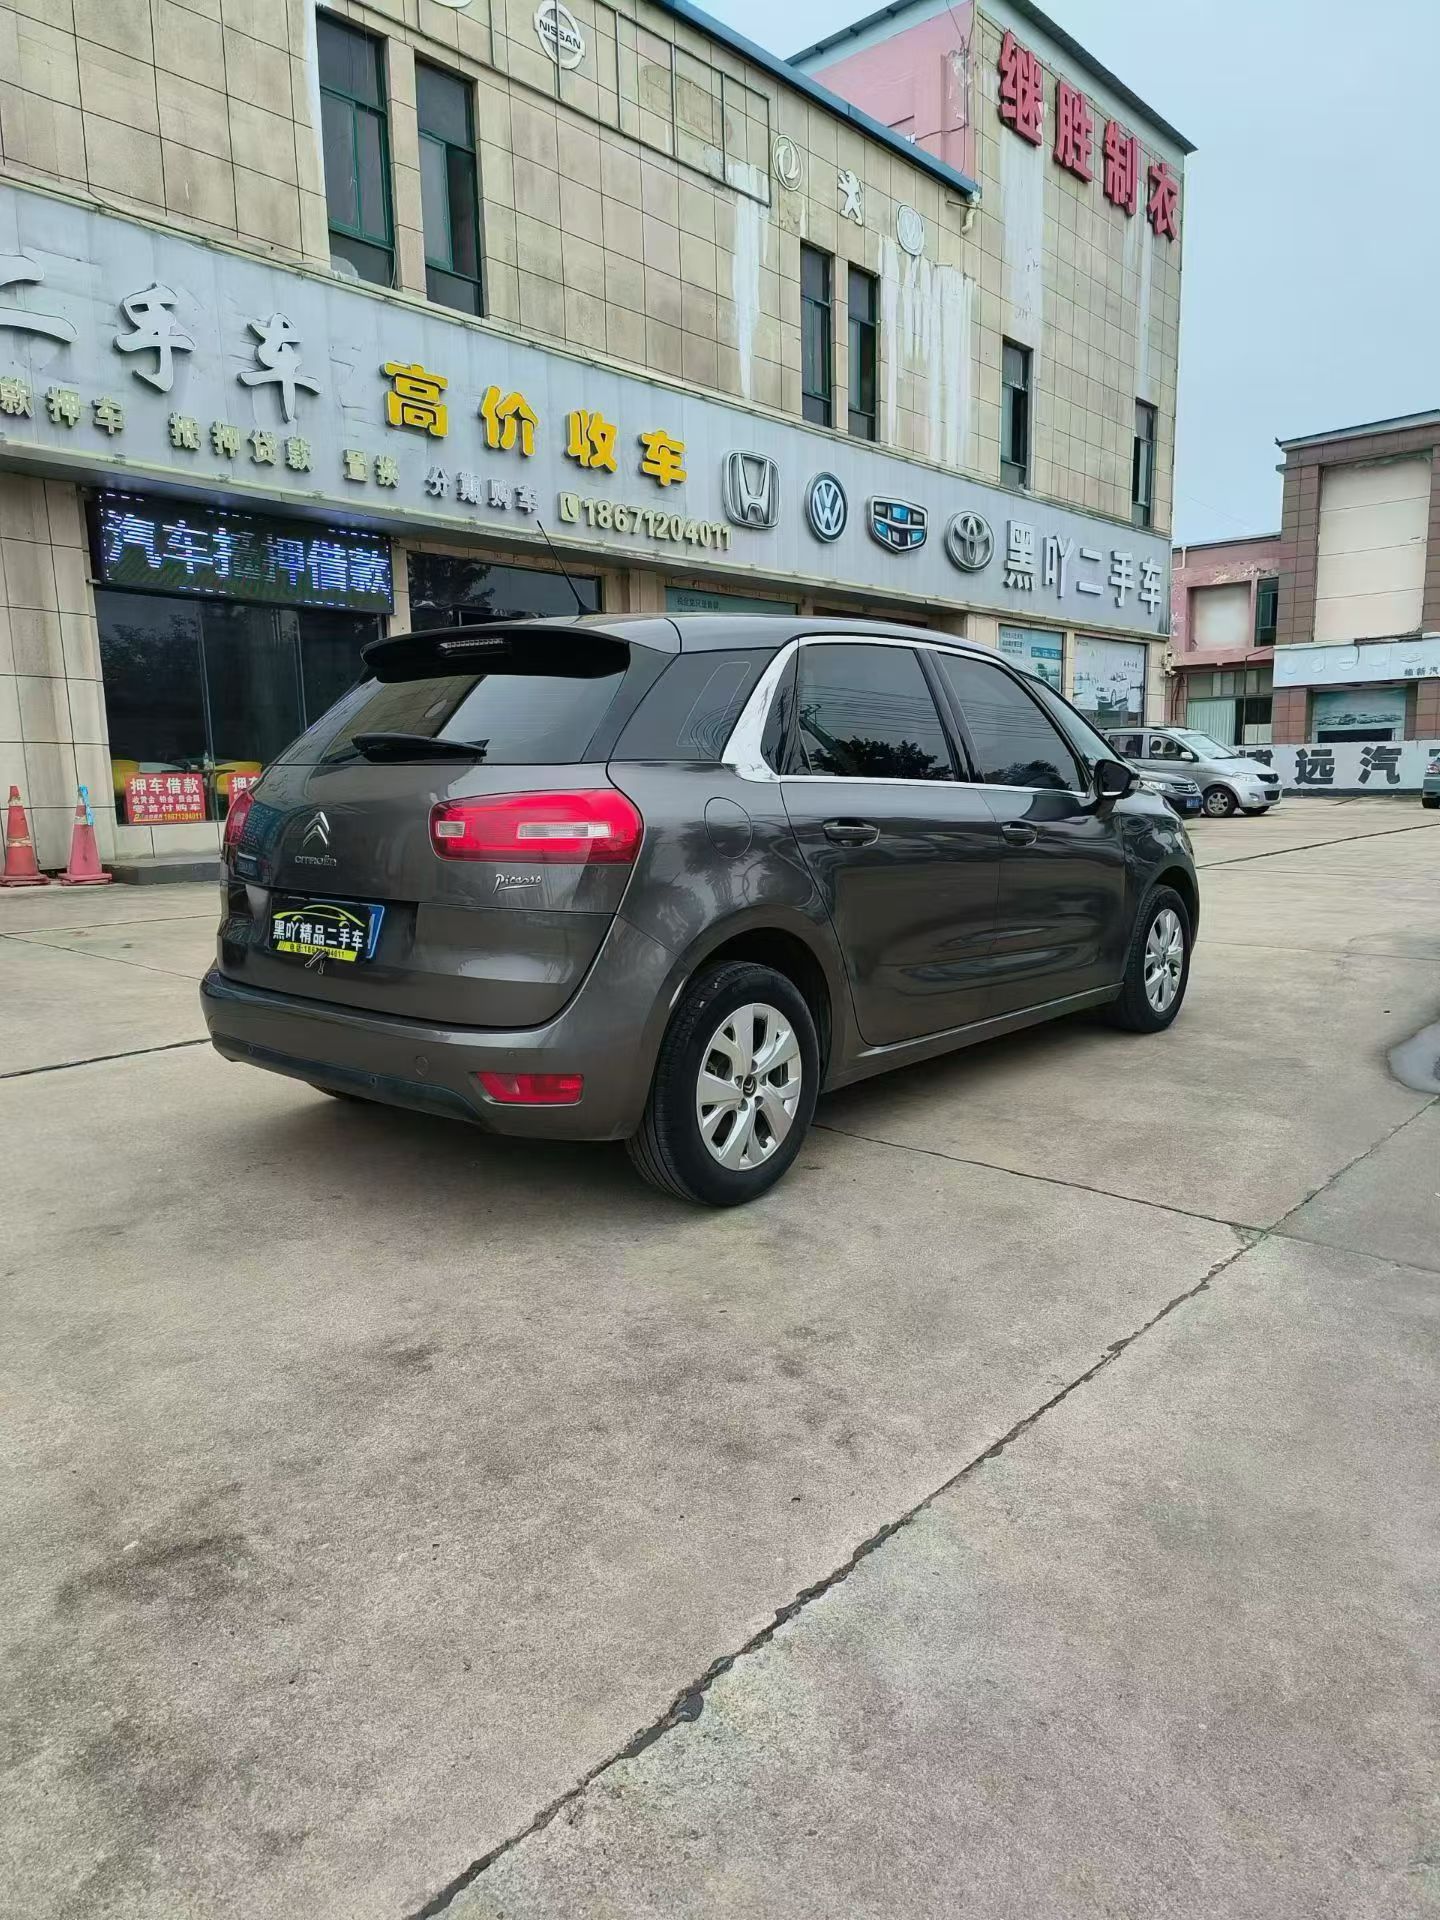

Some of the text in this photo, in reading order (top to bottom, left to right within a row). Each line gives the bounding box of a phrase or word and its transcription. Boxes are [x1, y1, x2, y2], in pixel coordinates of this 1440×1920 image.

[539, 19, 581, 50] NISSAN
[1000, 31, 1178, 241] 继胜制衣
[380, 361, 688, 487] 高价收车
[424, 465, 540, 515] 分期购车
[582, 497, 732, 551] 18671204011
[1003, 519, 1162, 614] 黑吖二手车
[130, 777, 200, 795] 押车借款
[492, 873, 542, 894] Picasso
[273, 920, 364, 951] 黑吖精品二手车
